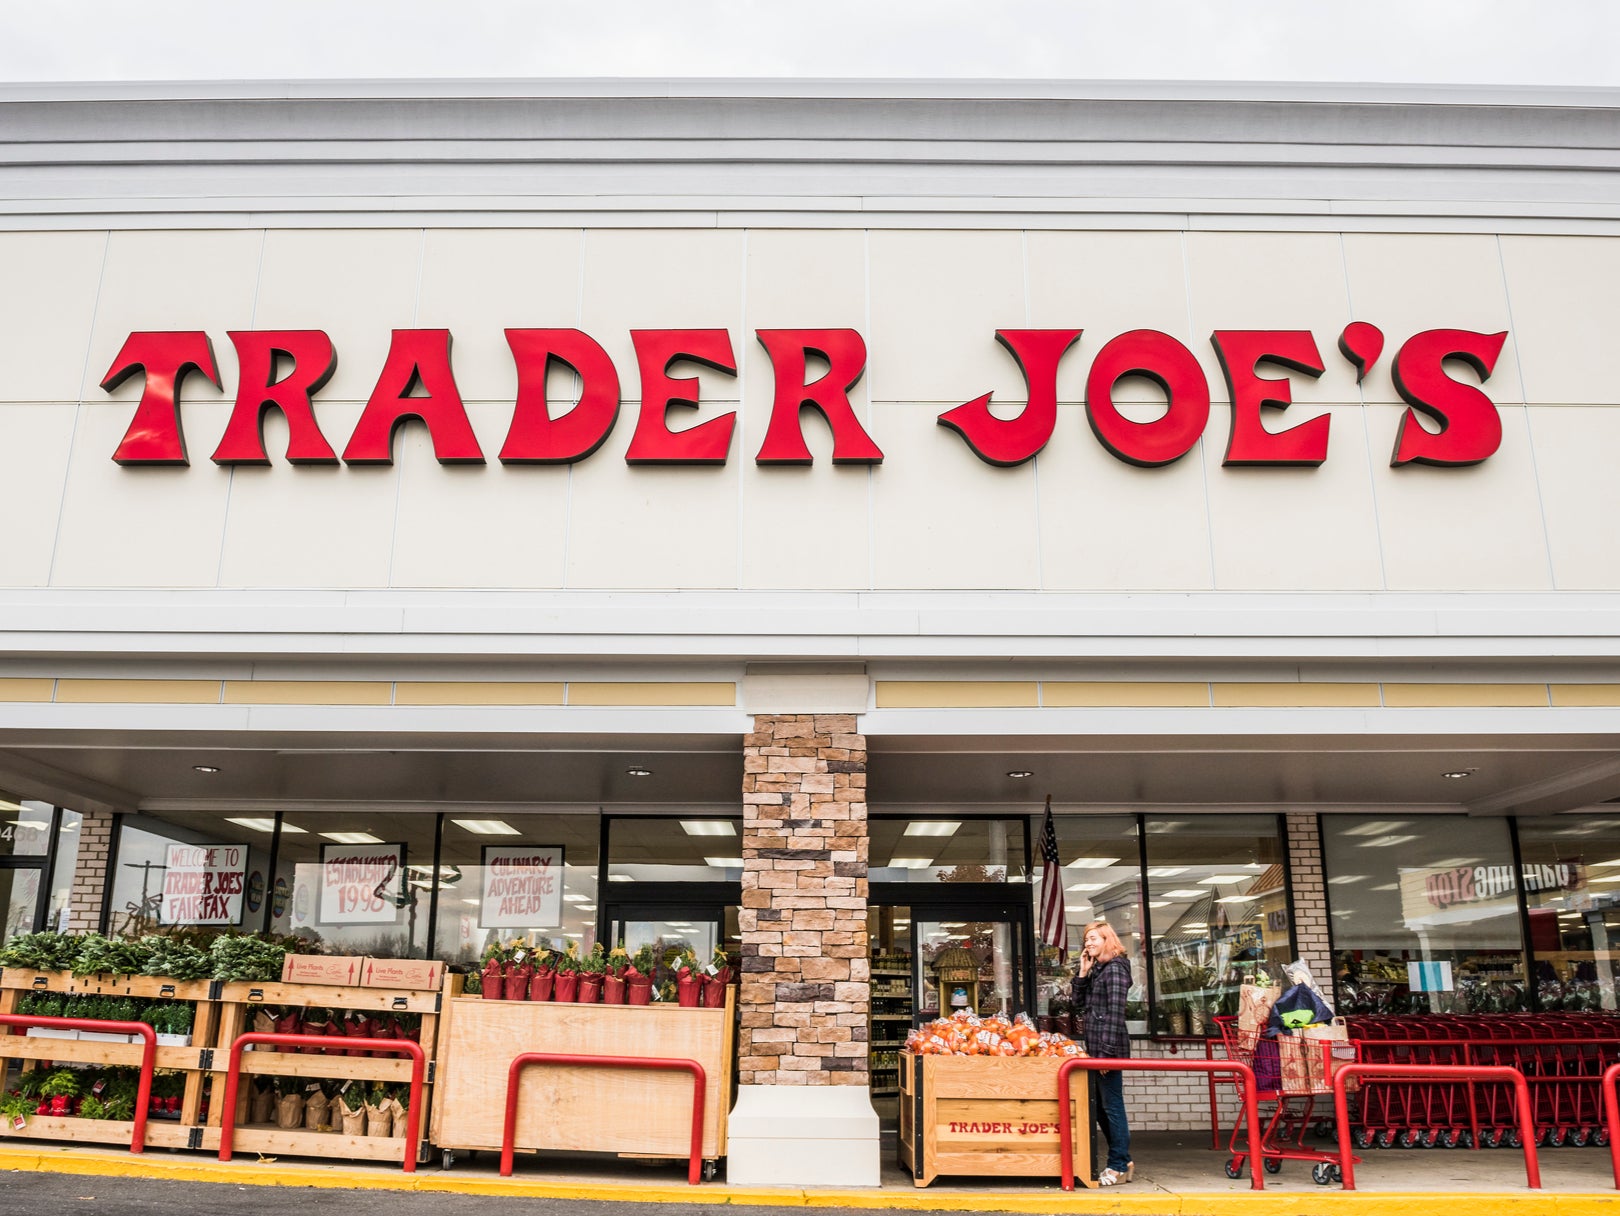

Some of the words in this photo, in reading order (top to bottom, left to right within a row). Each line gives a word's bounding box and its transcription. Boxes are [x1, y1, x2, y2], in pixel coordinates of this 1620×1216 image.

[99, 327, 885, 468] TRADER
[936, 321, 1509, 468] JOE'S
[171, 848, 220, 867] WELCOME
[225, 848, 239, 867] TO
[490, 856, 552, 876] CULINARY
[165, 872, 214, 894] TRADER
[487, 876, 554, 897] ADVENTURE
[169, 894, 231, 919] FAIRFAX
[498, 895, 542, 916] AHEAD
[948, 1122, 1013, 1134] TRADER
[1017, 1123, 1061, 1135] JOE'S
